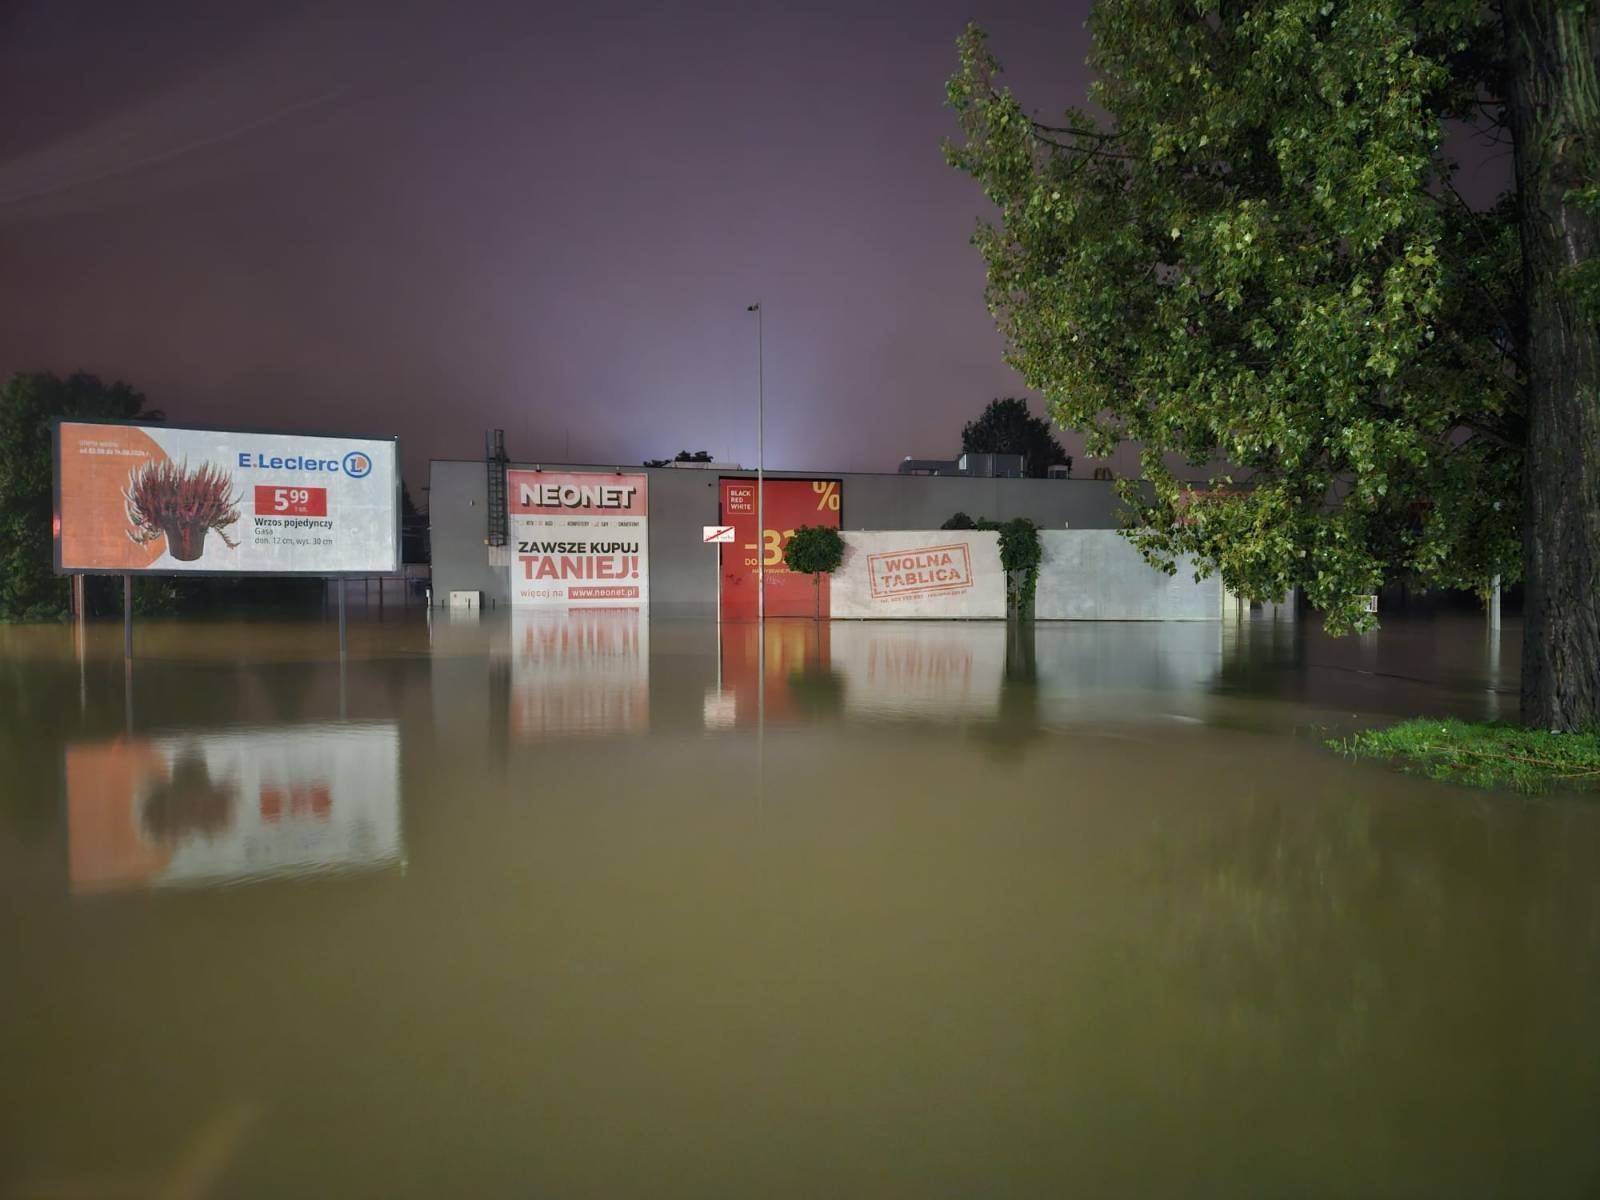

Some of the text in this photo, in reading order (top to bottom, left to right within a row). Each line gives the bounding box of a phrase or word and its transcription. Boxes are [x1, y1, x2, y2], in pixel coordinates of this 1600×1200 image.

[238, 452, 339, 472] E.Leclerc
[519, 483, 636, 509] NEONET
[254, 518, 333, 530] Wrzos pojedynczy
[518, 542, 639, 554] ZAWSZE KUPUJ
[518, 555, 639, 580] TANIEJ!
[884, 553, 952, 573] WOLNA
[880, 567, 961, 588] TABLICA
[520, 588, 550, 600] więcej
[572, 588, 636, 599] www.neonet.pl
